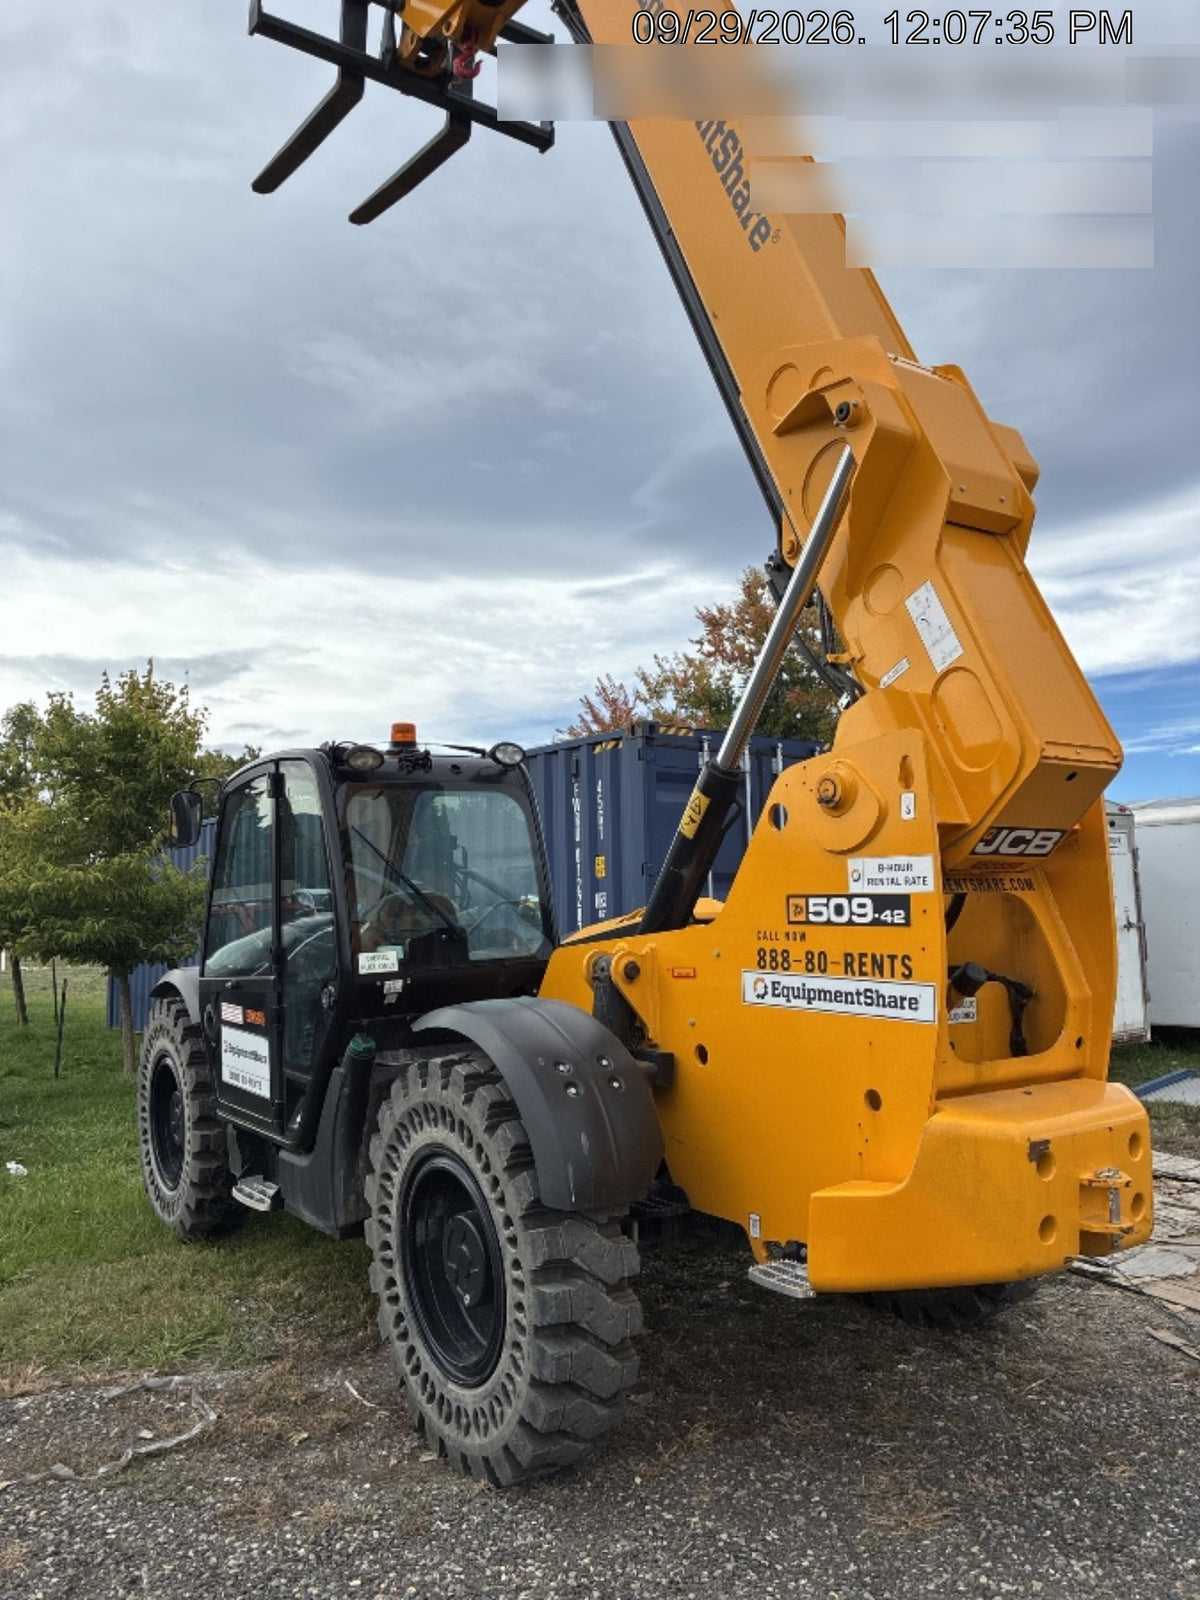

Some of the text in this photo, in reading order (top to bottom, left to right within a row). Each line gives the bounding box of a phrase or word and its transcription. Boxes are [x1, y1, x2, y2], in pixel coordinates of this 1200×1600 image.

[973, 830, 1062, 855] JCB
[904, 876, 928, 886] RATE
[757, 931, 806, 942] CALL NOW
[757, 948, 913, 979] 888-80-RENTS
[771, 981, 920, 1011] EquipmentShare
